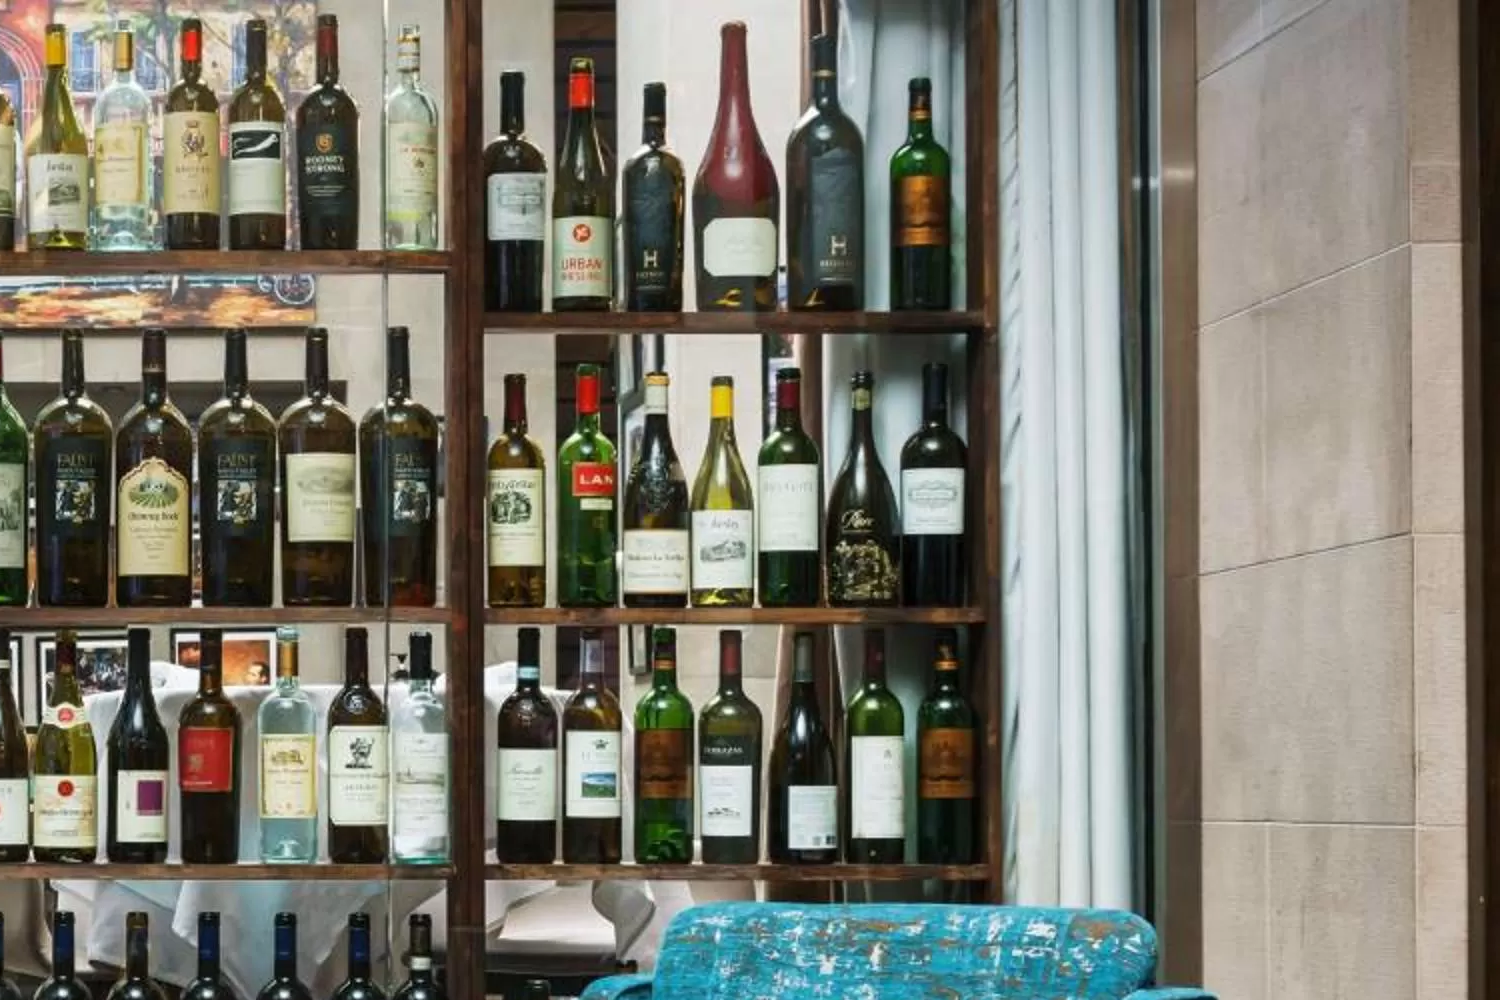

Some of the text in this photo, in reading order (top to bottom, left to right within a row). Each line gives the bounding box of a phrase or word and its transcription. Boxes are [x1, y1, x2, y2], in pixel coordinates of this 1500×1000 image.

[831, 235, 847, 256] H
[561, 257, 602, 271] URBAN
[643, 249, 658, 268] H
